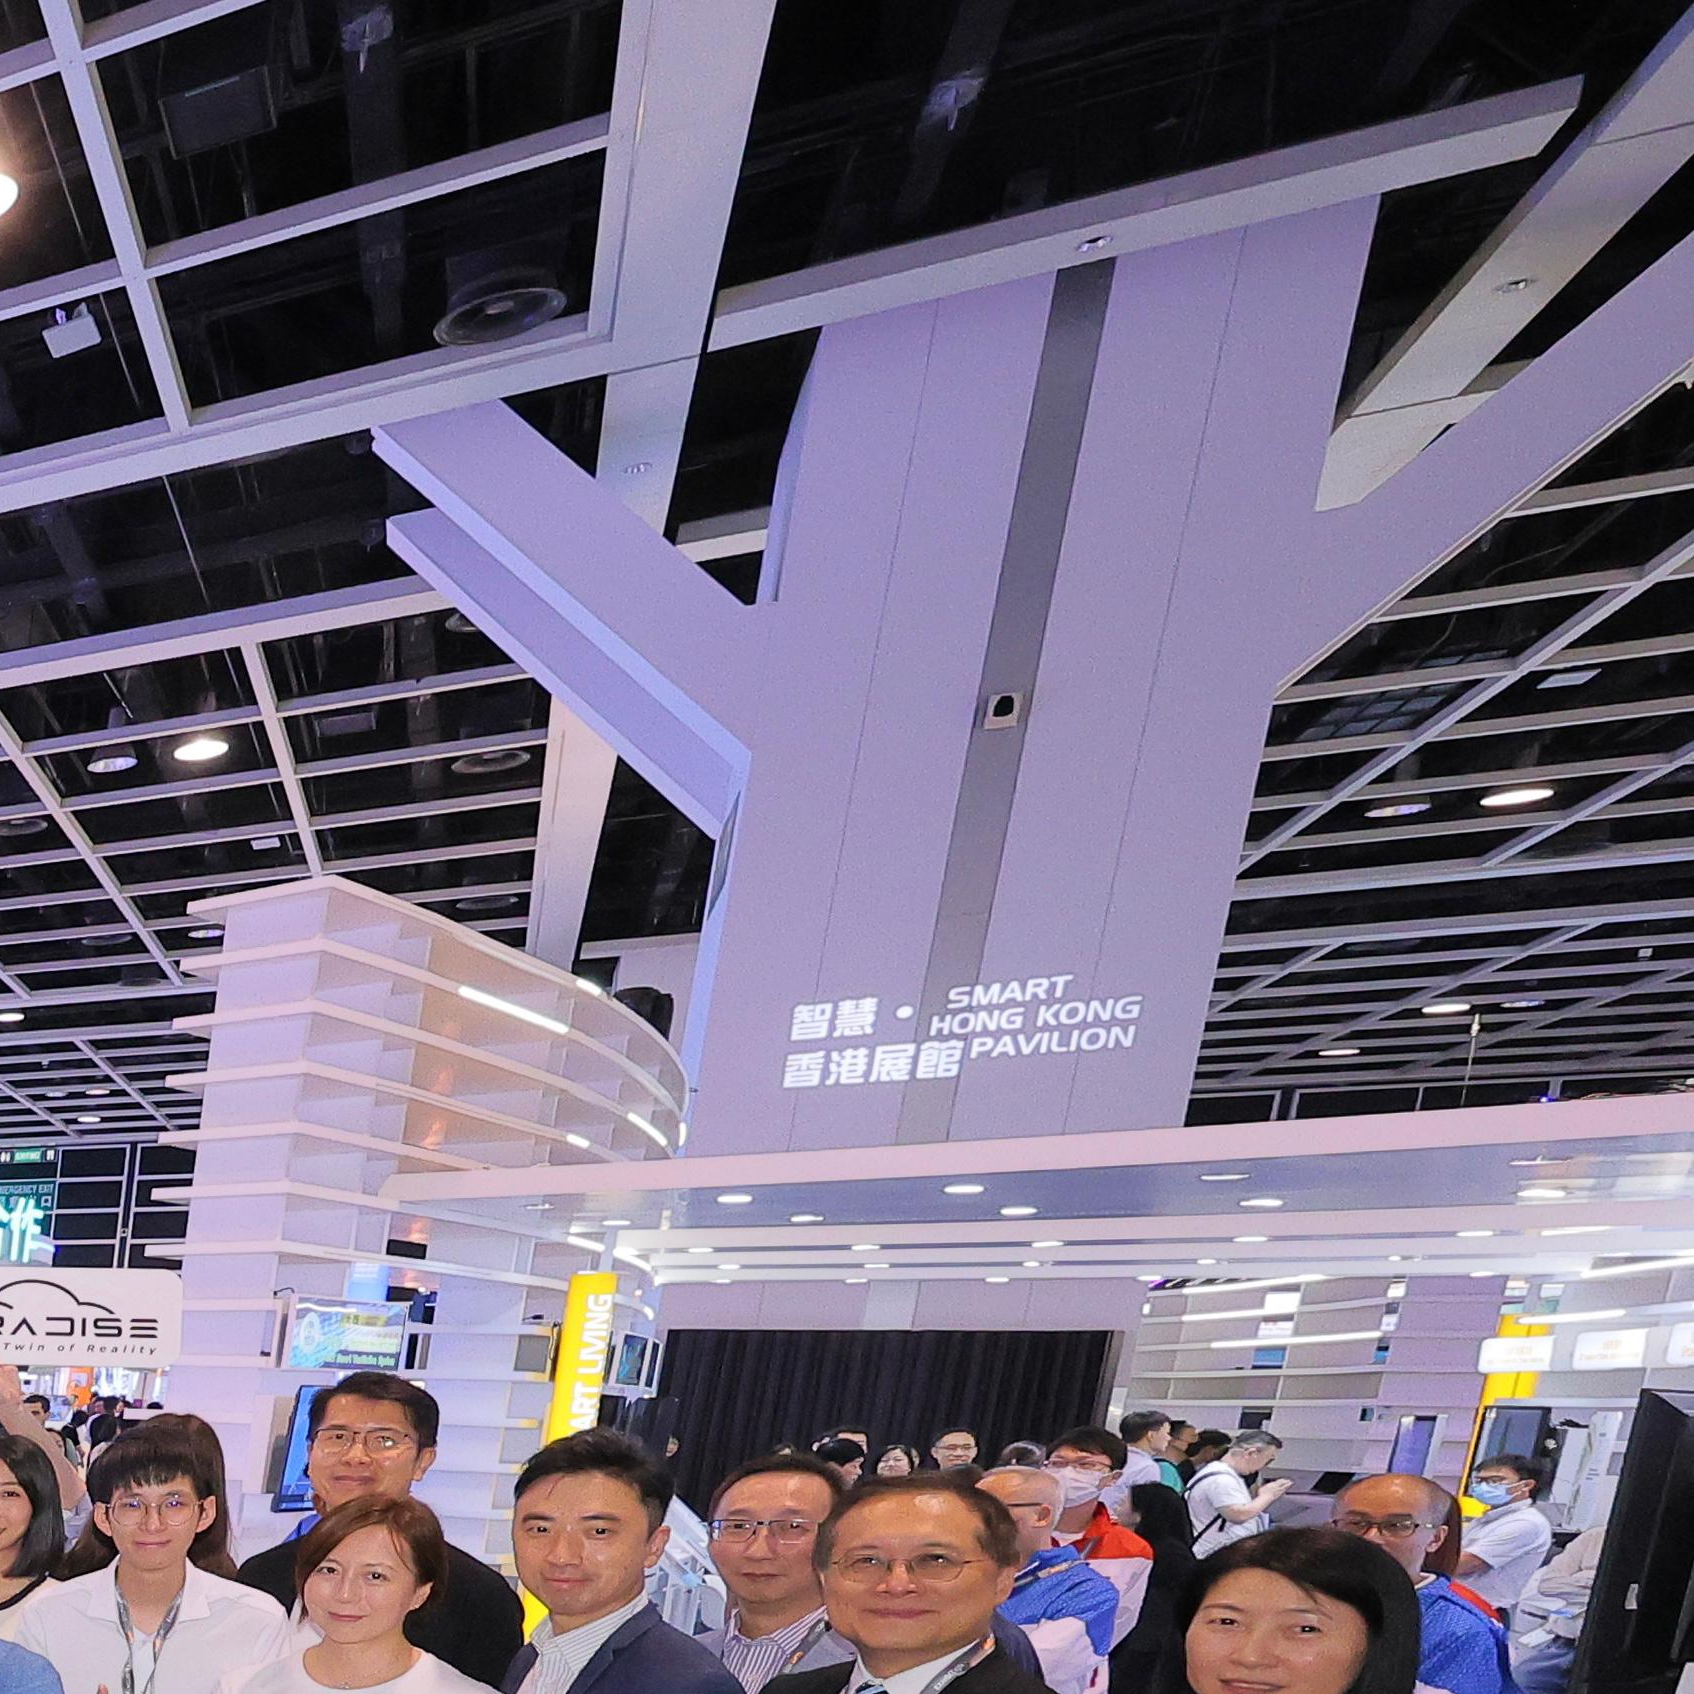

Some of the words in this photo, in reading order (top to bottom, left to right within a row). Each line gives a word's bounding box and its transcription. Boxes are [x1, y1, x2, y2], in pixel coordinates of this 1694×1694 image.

[946, 974, 1074, 1009] SMART
[790, 997, 879, 1042] 智慧
[928, 1007, 1026, 1037] HONG
[1036, 995, 1144, 1028] KONG
[969, 1025, 1136, 1059] PAVILION
[782, 1039, 964, 1088] 香港展館
[3, 1342, 45, 1352] Twin
[57, 1343, 76, 1352] of
[87, 1344, 158, 1356] Reality
[581, 1293, 613, 1376] LIVING
